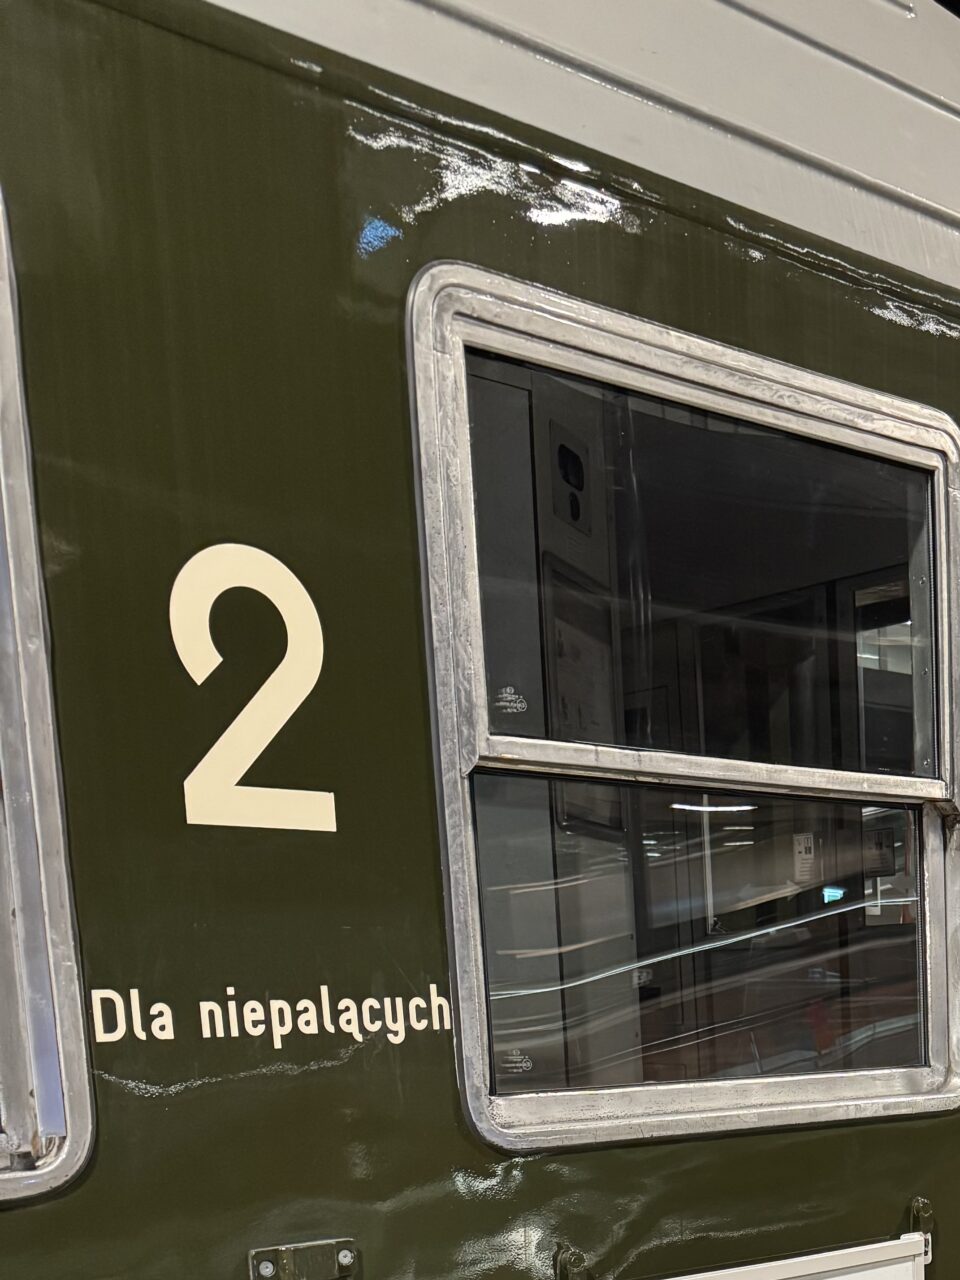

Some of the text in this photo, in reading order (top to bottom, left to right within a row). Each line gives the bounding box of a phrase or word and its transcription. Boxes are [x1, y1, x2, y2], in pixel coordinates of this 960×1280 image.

[169, 542, 337, 833] 2
[91, 983, 451, 1050] Dla niepalących
